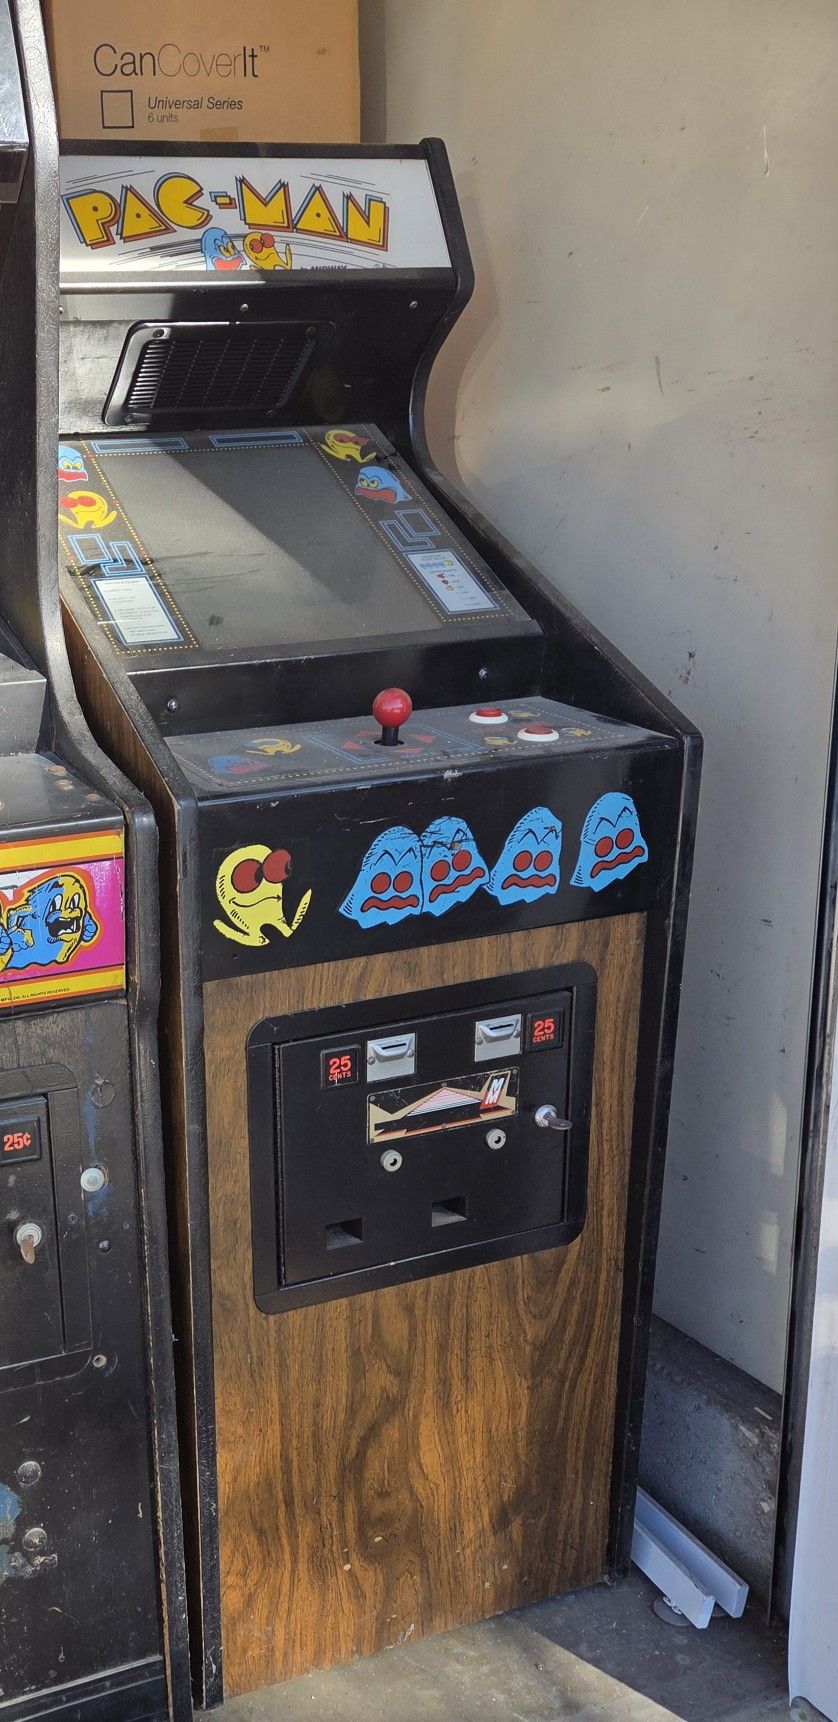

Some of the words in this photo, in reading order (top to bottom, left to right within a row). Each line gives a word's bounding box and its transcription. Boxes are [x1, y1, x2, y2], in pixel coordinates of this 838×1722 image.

[147, 96, 203, 110] Universal
[206, 96, 243, 111] Series
[147, 112, 154, 123] 6
[157, 112, 179, 123] units
[60, 171, 390, 252] PAC-MAN
[47, 987, 71, 995] RESERVED
[533, 1018, 555, 1037] 25
[532, 1033, 555, 1043] CENTS
[329, 1055, 352, 1074] 25
[328, 1070, 352, 1081] CENTS
[3, 1131, 32, 1152] 25¢
